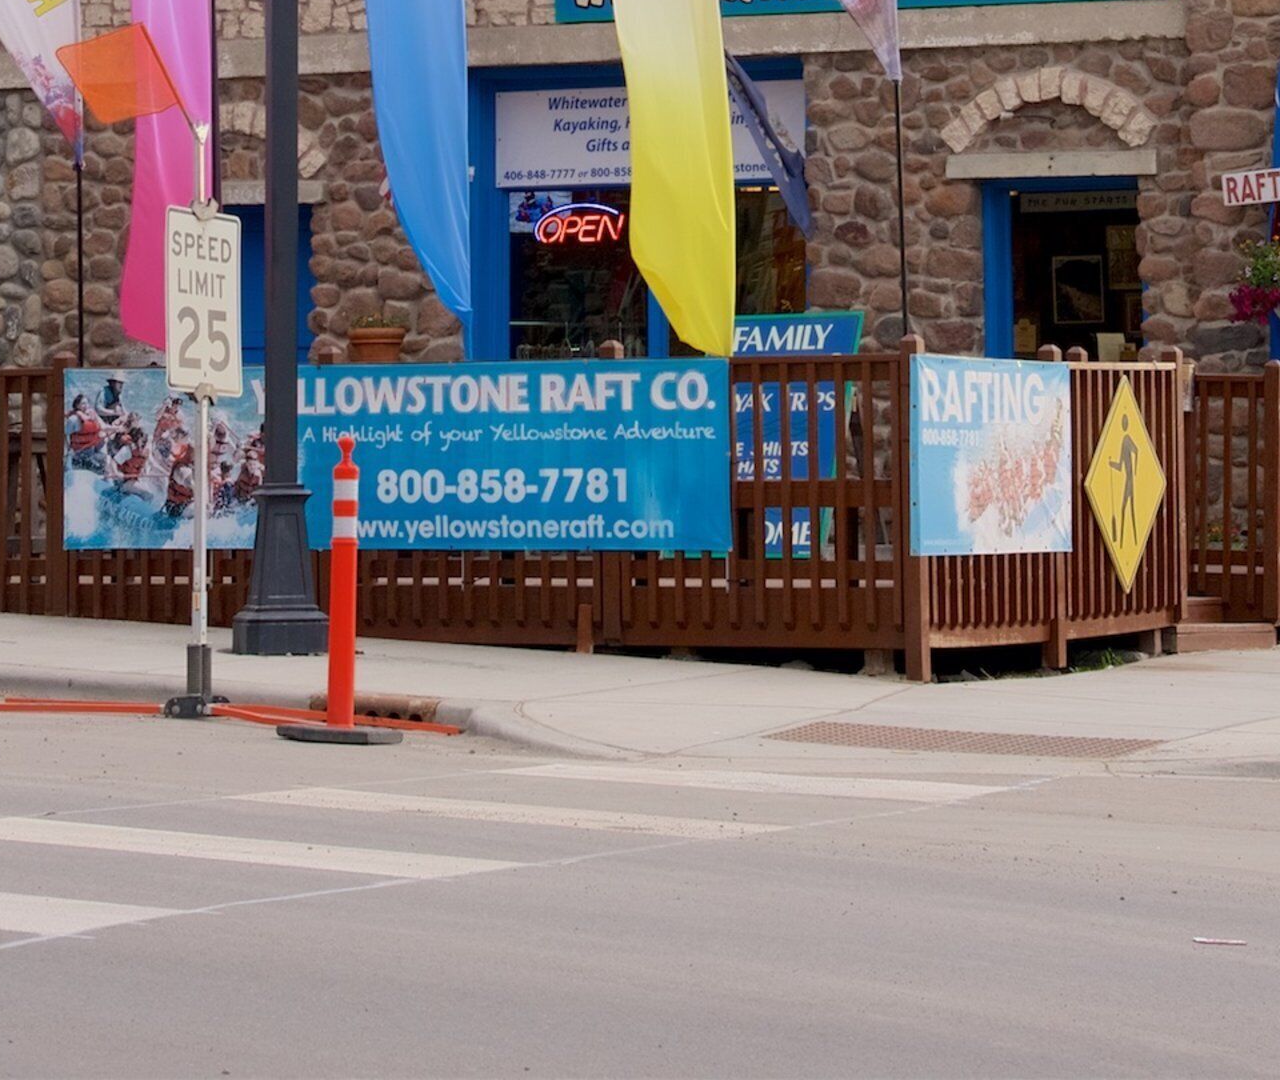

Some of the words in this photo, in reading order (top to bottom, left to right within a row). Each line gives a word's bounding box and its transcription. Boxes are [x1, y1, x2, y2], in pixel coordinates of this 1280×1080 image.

[548, 95, 627, 111] Whitewater
[553, 118, 621, 135] Kayaking,
[586, 138, 619, 153] Gifts
[504, 168, 575, 181] 406-848-7777
[578, 170, 588, 178] or
[1226, 172, 1280, 204] RAFT
[539, 215, 624, 243] OPEN
[172, 230, 232, 263] SPEED
[178, 267, 226, 299] LIMIT
[177, 306, 231, 372] 25
[733, 323, 834, 352] FAMILY
[251, 374, 529, 415] YLLOWSTONE
[540, 372, 640, 412] RAFT
[650, 370, 716, 411] CO.
[922, 368, 1045, 424] RAFTING
[302, 428, 315, 442] A
[411, 421, 432, 446] of
[439, 427, 483, 451] your
[489, 422, 608, 441] Yellowstone
[613, 420, 716, 439] Adventure
[376, 468, 627, 503] 800-858-7781
[357, 515, 674, 543] ww.yellowstoneraft.com
